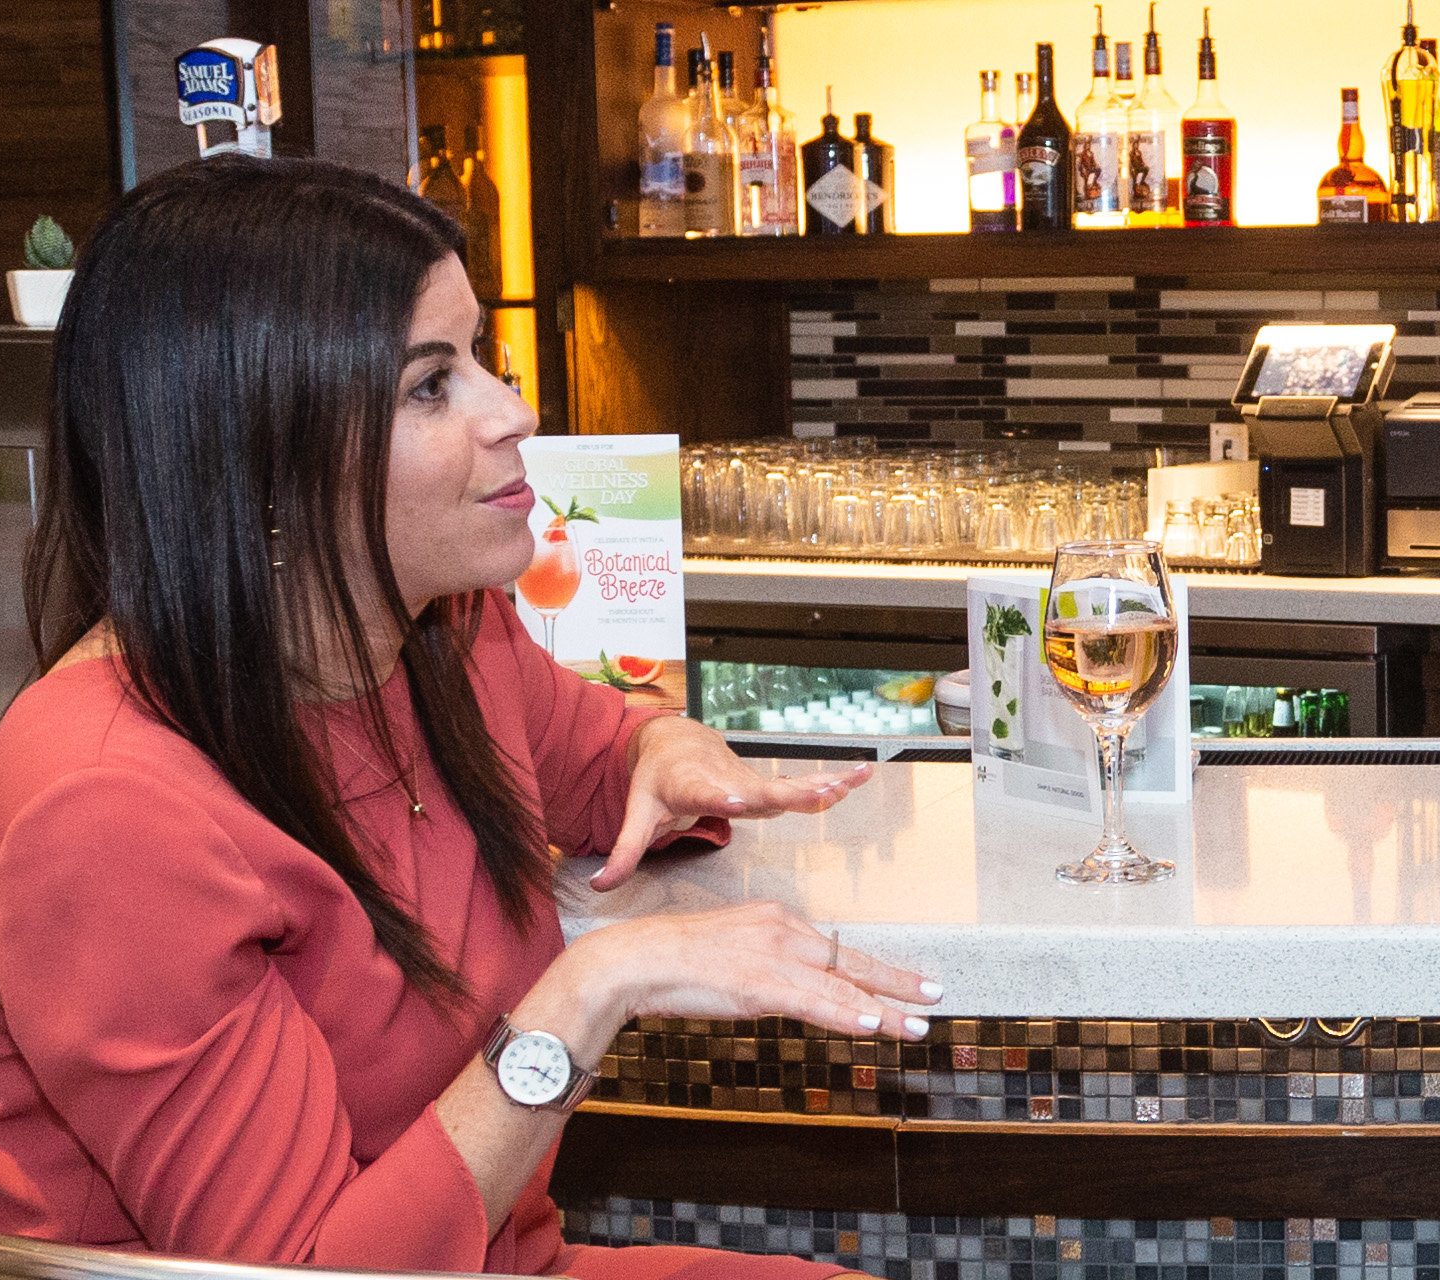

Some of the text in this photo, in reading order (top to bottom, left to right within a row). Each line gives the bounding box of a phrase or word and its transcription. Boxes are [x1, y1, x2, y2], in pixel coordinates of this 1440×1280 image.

[178, 61, 234, 81] SAMUEL
[183, 77, 231, 95] ADAMS
[182, 105, 234, 121] SEASONAL
[564, 458, 629, 473] GLOBAL
[546, 472, 649, 490] WELLNESS
[600, 489, 637, 505] DAY
[584, 548, 678, 577] Botanical
